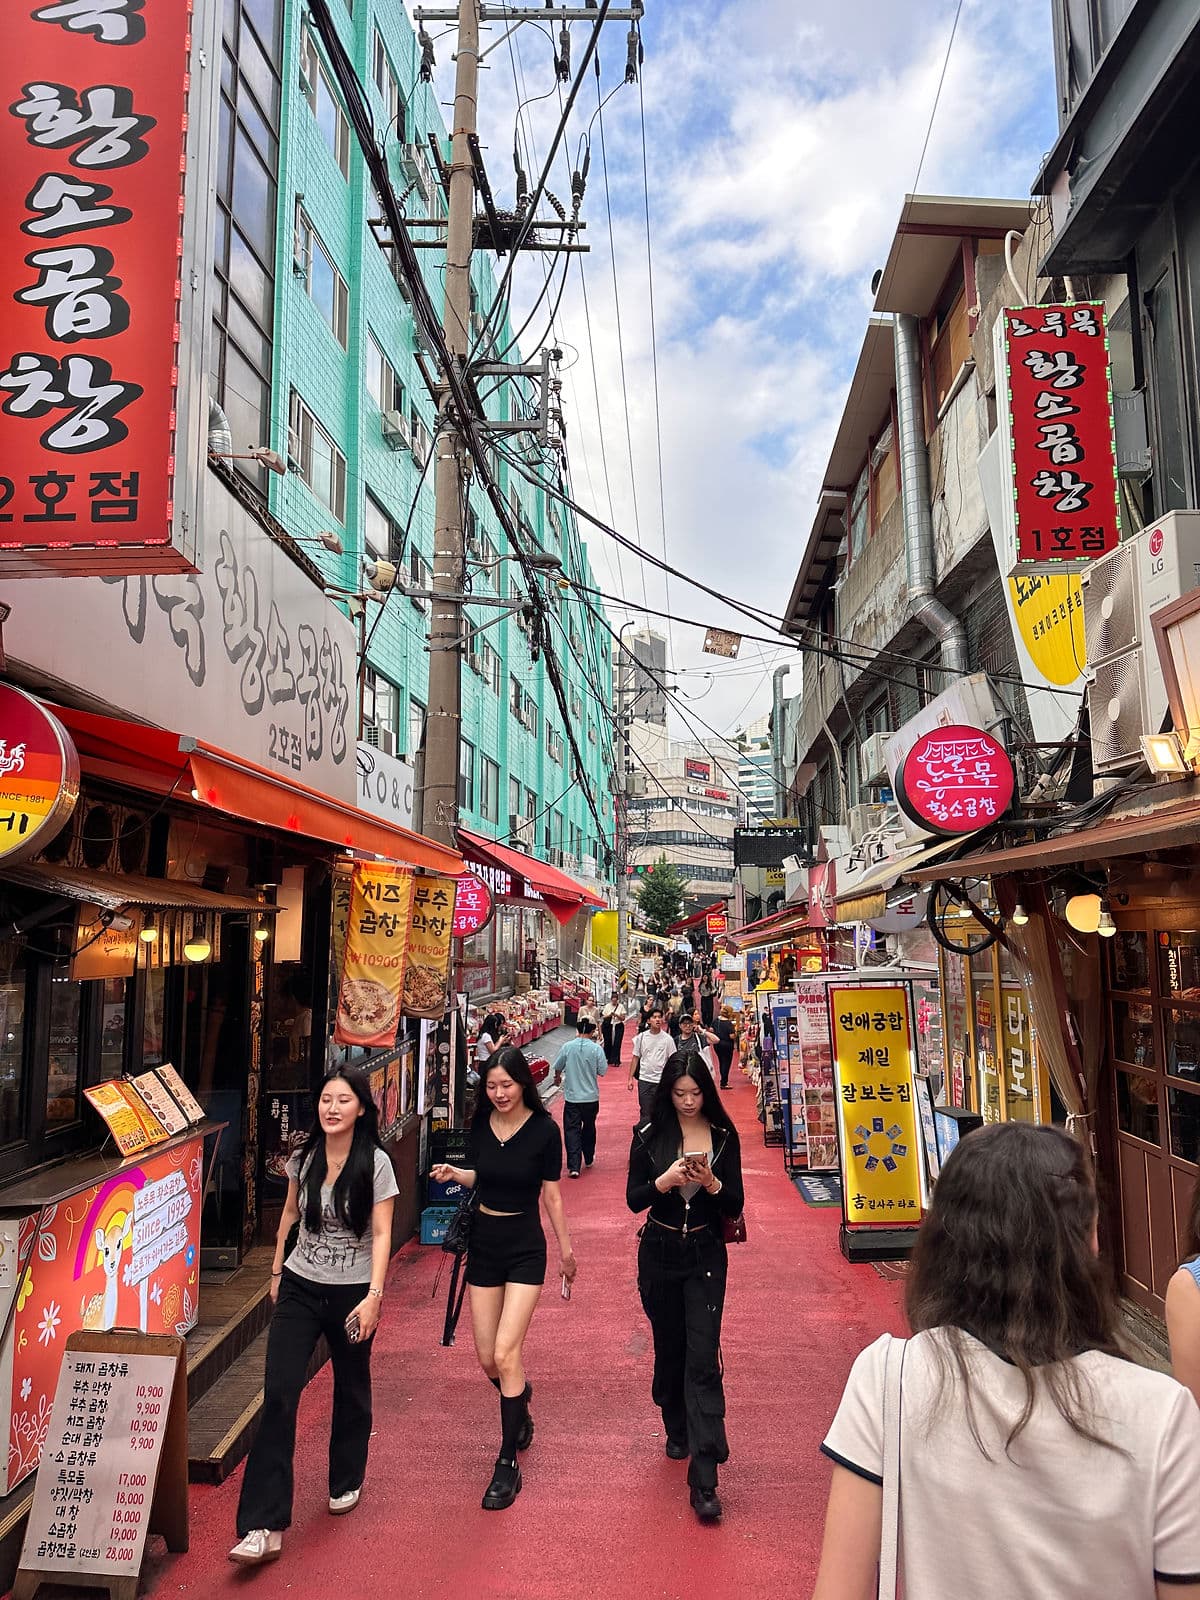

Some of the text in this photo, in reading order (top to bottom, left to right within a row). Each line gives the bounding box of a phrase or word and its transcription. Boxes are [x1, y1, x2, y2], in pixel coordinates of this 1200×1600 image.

[0, 83, 156, 454] 황소곱창
[1010, 310, 1098, 337] 노루목
[1021, 351, 1093, 512] 황소곱창
[1031, 527, 1105, 552] 1호점
[1151, 558, 1164, 575] LG
[215, 530, 349, 765] 황소곱창
[268, 723, 302, 770] 2호점
[926, 797, 997, 821] 황소곱창
[362, 881, 400, 903] 치즈
[414, 887, 449, 911] 부추
[359, 909, 400, 938] 곱창
[412, 914, 448, 937] 막창
[839, 1012, 904, 1031] 연애궁합
[858, 1047, 890, 1067] 제일
[136, 1197, 185, 1244] since 1993
[75, 1363, 129, 1377] 돼지 곱창류
[73, 1380, 113, 1396] 부추 막창
[136, 1385, 164, 1398] 10,900
[70, 1397, 109, 1414] 부추 곱창
[136, 1402, 161, 1416] 9,900
[66, 1415, 106, 1430] 치즈 곱창
[130, 1420, 158, 1433] 10,900
[61, 1431, 103, 1447] 순대 곱창
[130, 1436, 155, 1450] 9,900
[54, 1450, 97, 1466] 소 곱창류
[118, 1473, 147, 1487] 17,000
[116, 1492, 145, 1505] 18,000
[112, 1510, 141, 1524] 18,000
[47, 1522, 78, 1540] 소곱창
[110, 1528, 138, 1542] 19,000
[37, 1541, 77, 1559] 곱창전골
[105, 1547, 134, 1562] 28,000
